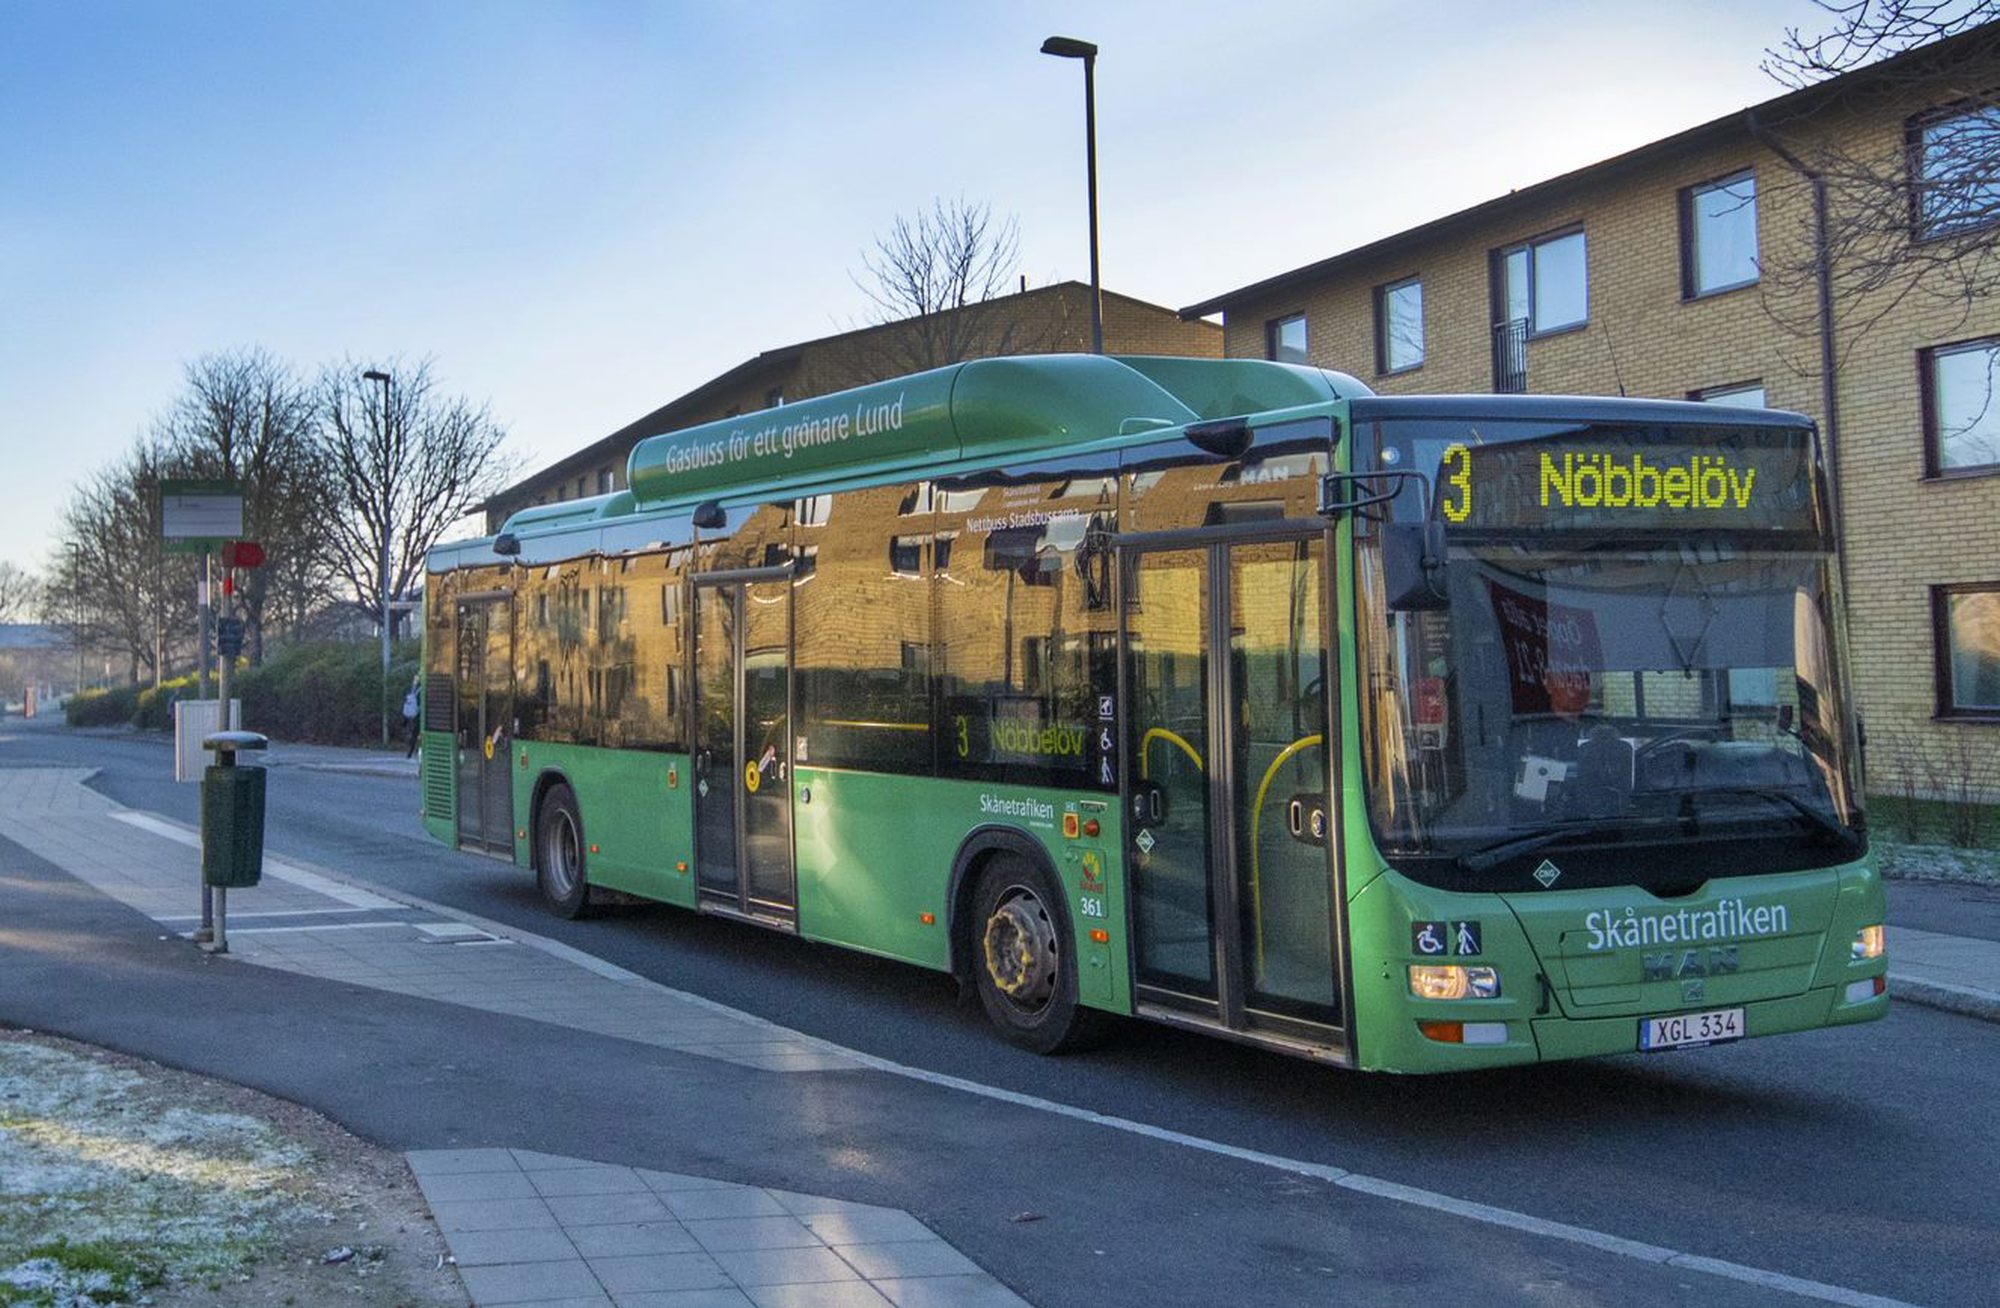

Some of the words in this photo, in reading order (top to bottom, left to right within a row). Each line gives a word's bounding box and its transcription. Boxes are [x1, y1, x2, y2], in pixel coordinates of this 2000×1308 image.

[665, 438, 725, 475] Gasbuss
[728, 429, 750, 461] för
[753, 426, 779, 457] ett
[781, 412, 850, 458] grönare
[855, 392, 905, 437] Lund
[1443, 444, 1472, 523] 3
[1539, 452, 1756, 509] Nöbbelöv
[966, 515, 1008, 534] Nettbuss
[955, 714, 970, 757] 3
[990, 719, 1084, 756] Nöbbelöv
[980, 794, 1054, 819] Skånetrafiken
[1081, 897, 1103, 917] 361
[1585, 899, 1788, 950] Skånetrafiken
[1657, 1018, 1693, 1044] XGL
[1700, 1012, 1736, 1038] 334
